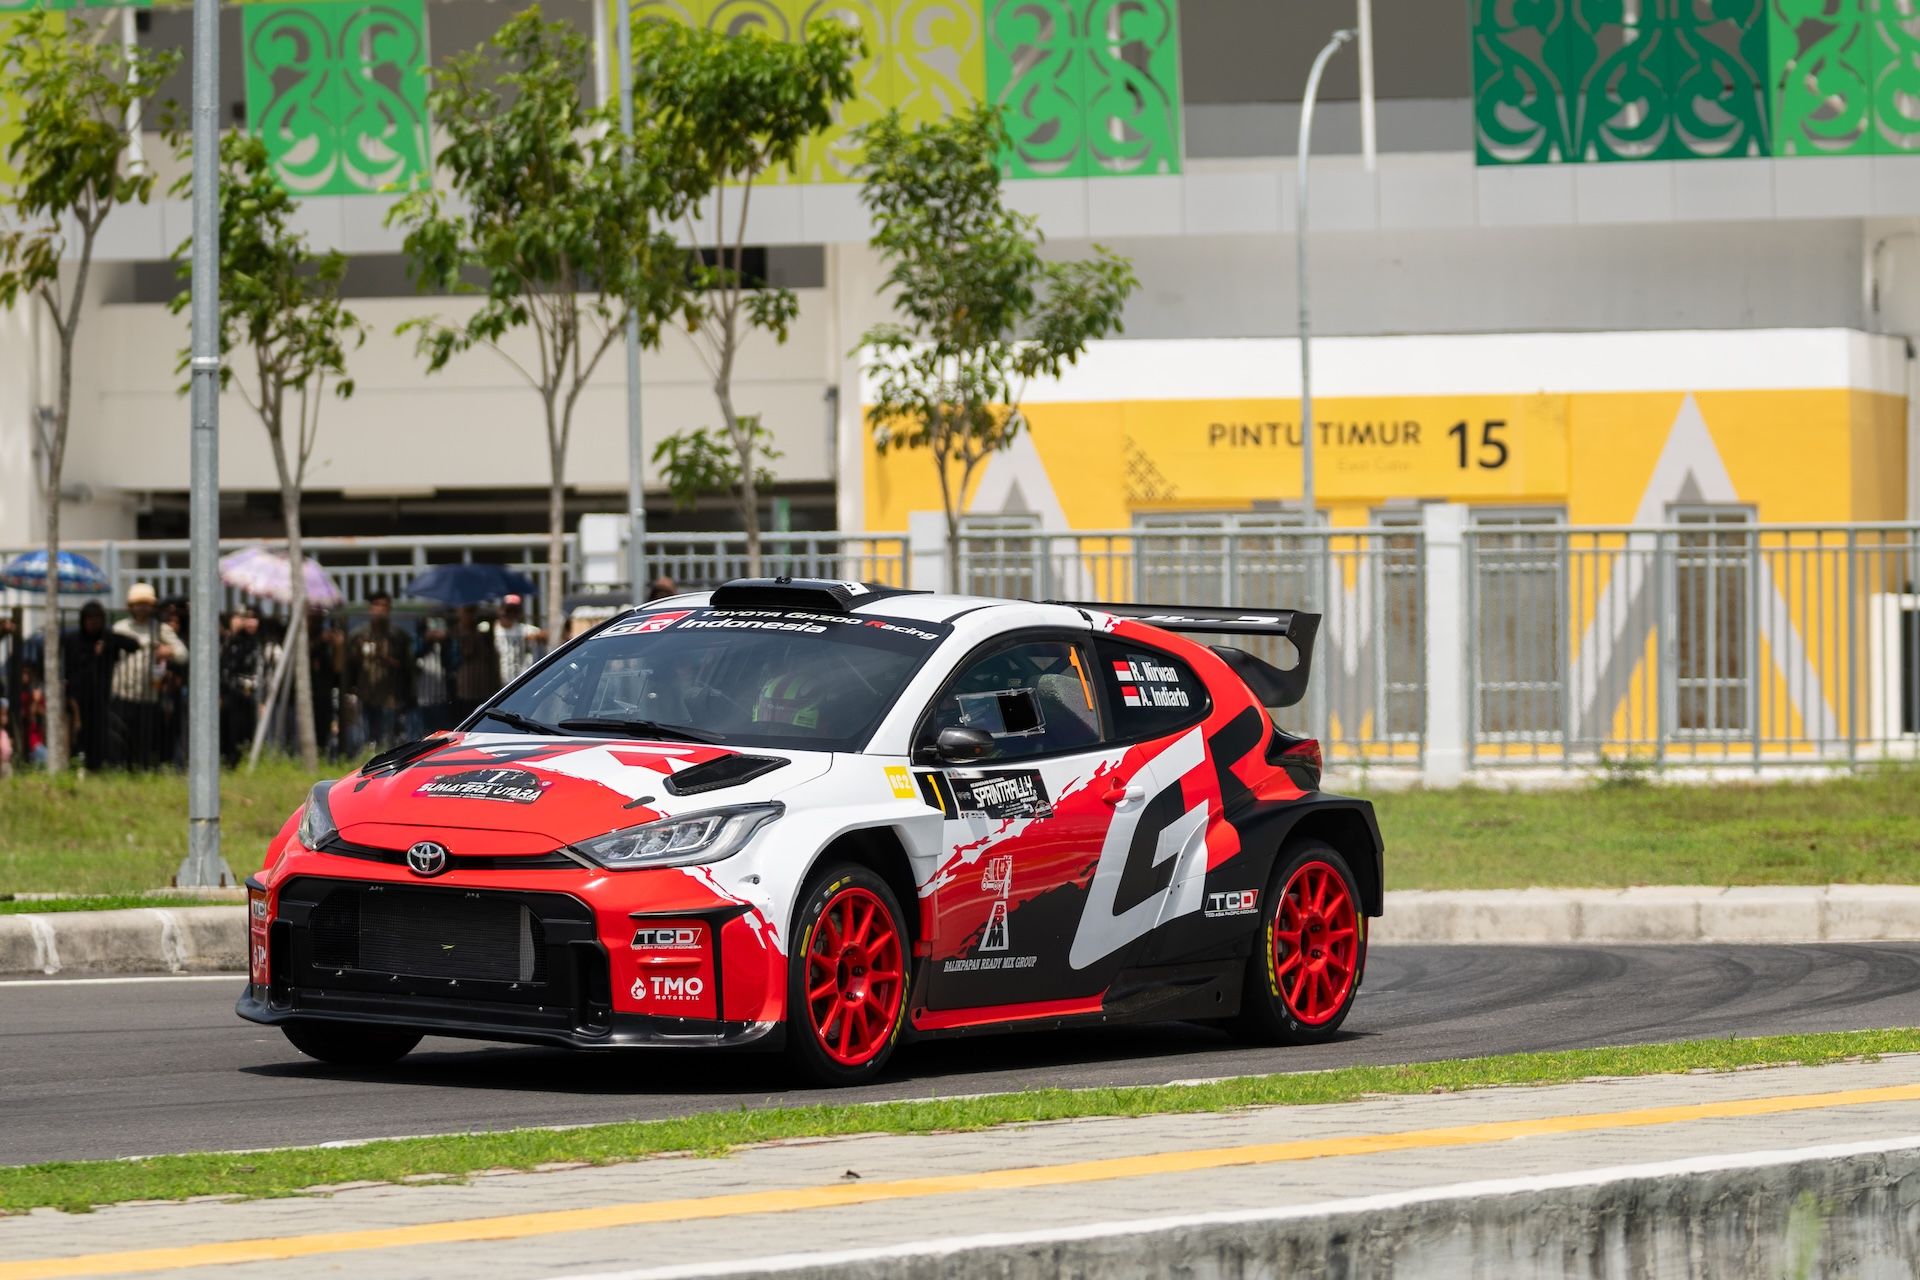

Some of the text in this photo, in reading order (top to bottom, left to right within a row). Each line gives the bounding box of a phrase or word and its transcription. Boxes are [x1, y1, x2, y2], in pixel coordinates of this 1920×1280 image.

[1208, 419, 1509, 469] PINTU TIMUR 15
[678, 618, 829, 634] Indonesia
[701, 609, 940, 641] TOYOTA GAZOO Racing
[1128, 661, 1179, 683] R. Nirwan
[1139, 686, 1190, 707] A. Indiarto
[417, 782, 492, 793] SUMATERA
[493, 787, 542, 801] UTARA
[1210, 892, 1254, 909] TCD
[637, 929, 694, 944] TCD
[943, 956, 1038, 972] BALIKPAPAN READY MIX GROUP
[650, 976, 704, 995] TMO
